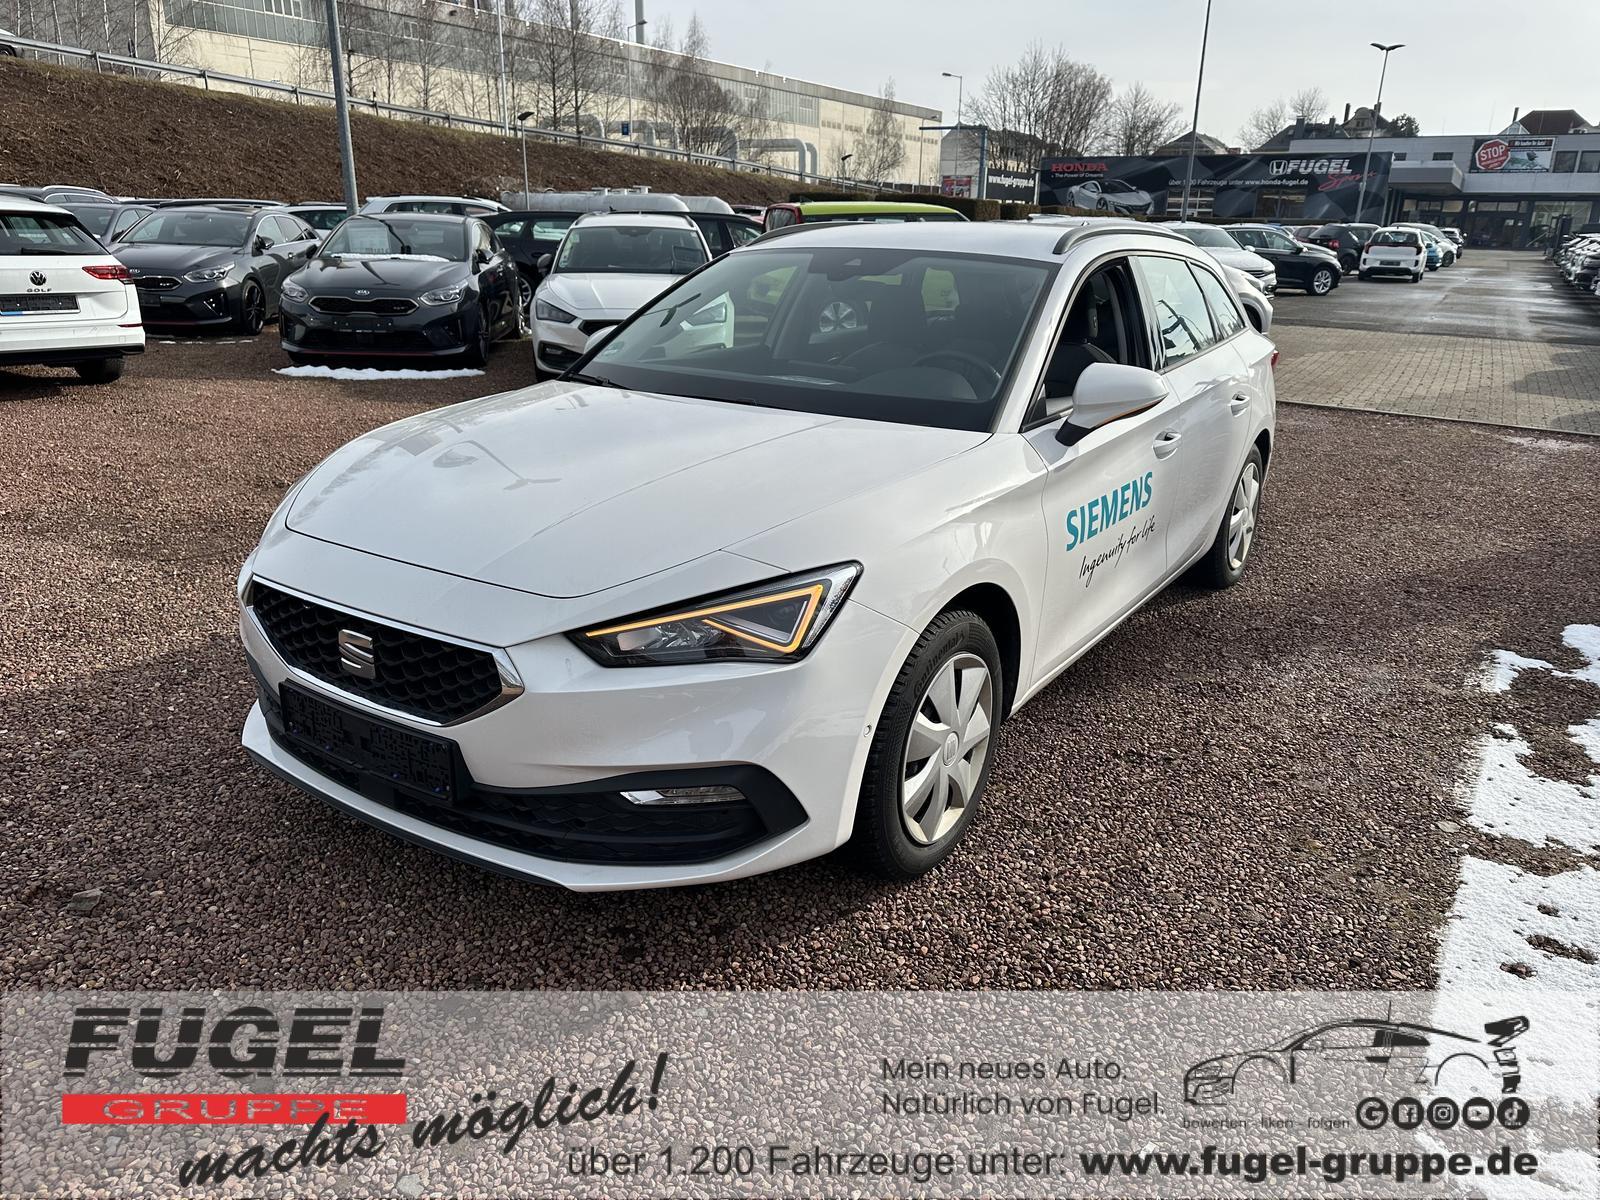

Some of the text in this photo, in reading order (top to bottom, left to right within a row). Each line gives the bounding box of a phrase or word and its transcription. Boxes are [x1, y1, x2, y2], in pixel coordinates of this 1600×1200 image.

[1480, 145, 1506, 161] STOP
[1051, 163, 1108, 172] HONDA
[1287, 159, 1353, 174] FUGEL
[1066, 471, 1153, 552] SIEMENS
[1079, 515, 1156, 588] Ingenuity for life
